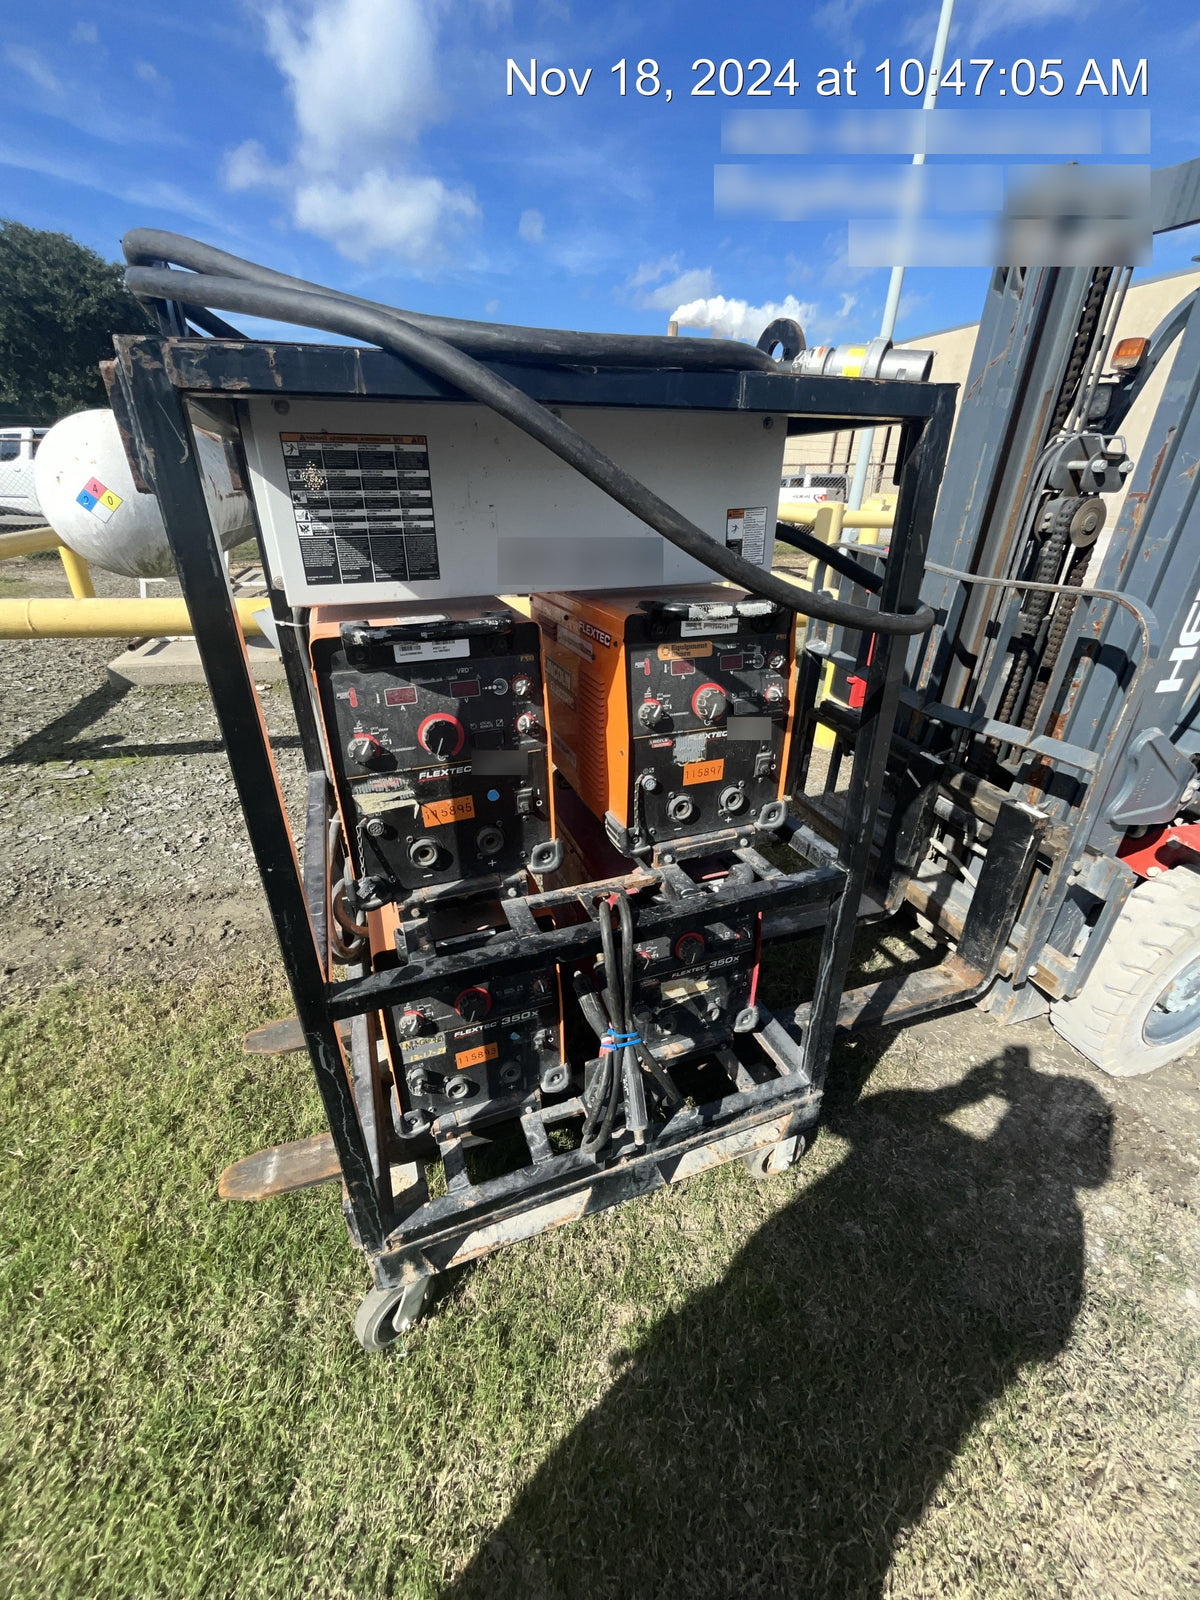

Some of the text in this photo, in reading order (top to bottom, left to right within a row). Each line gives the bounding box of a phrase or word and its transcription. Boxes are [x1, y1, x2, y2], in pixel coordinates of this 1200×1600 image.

[92, 484, 98, 493] 4
[107, 495, 114, 506] 0
[578, 620, 611, 647] FLEXTEC
[1155, 588, 1200, 693] HE
[671, 642, 708, 651] Equipment
[418, 765, 472, 780] FLEXTEC
[685, 765, 722, 780] 115897
[671, 964, 707, 978] FLEXTEC
[454, 1021, 498, 1038] FLEXTEC
